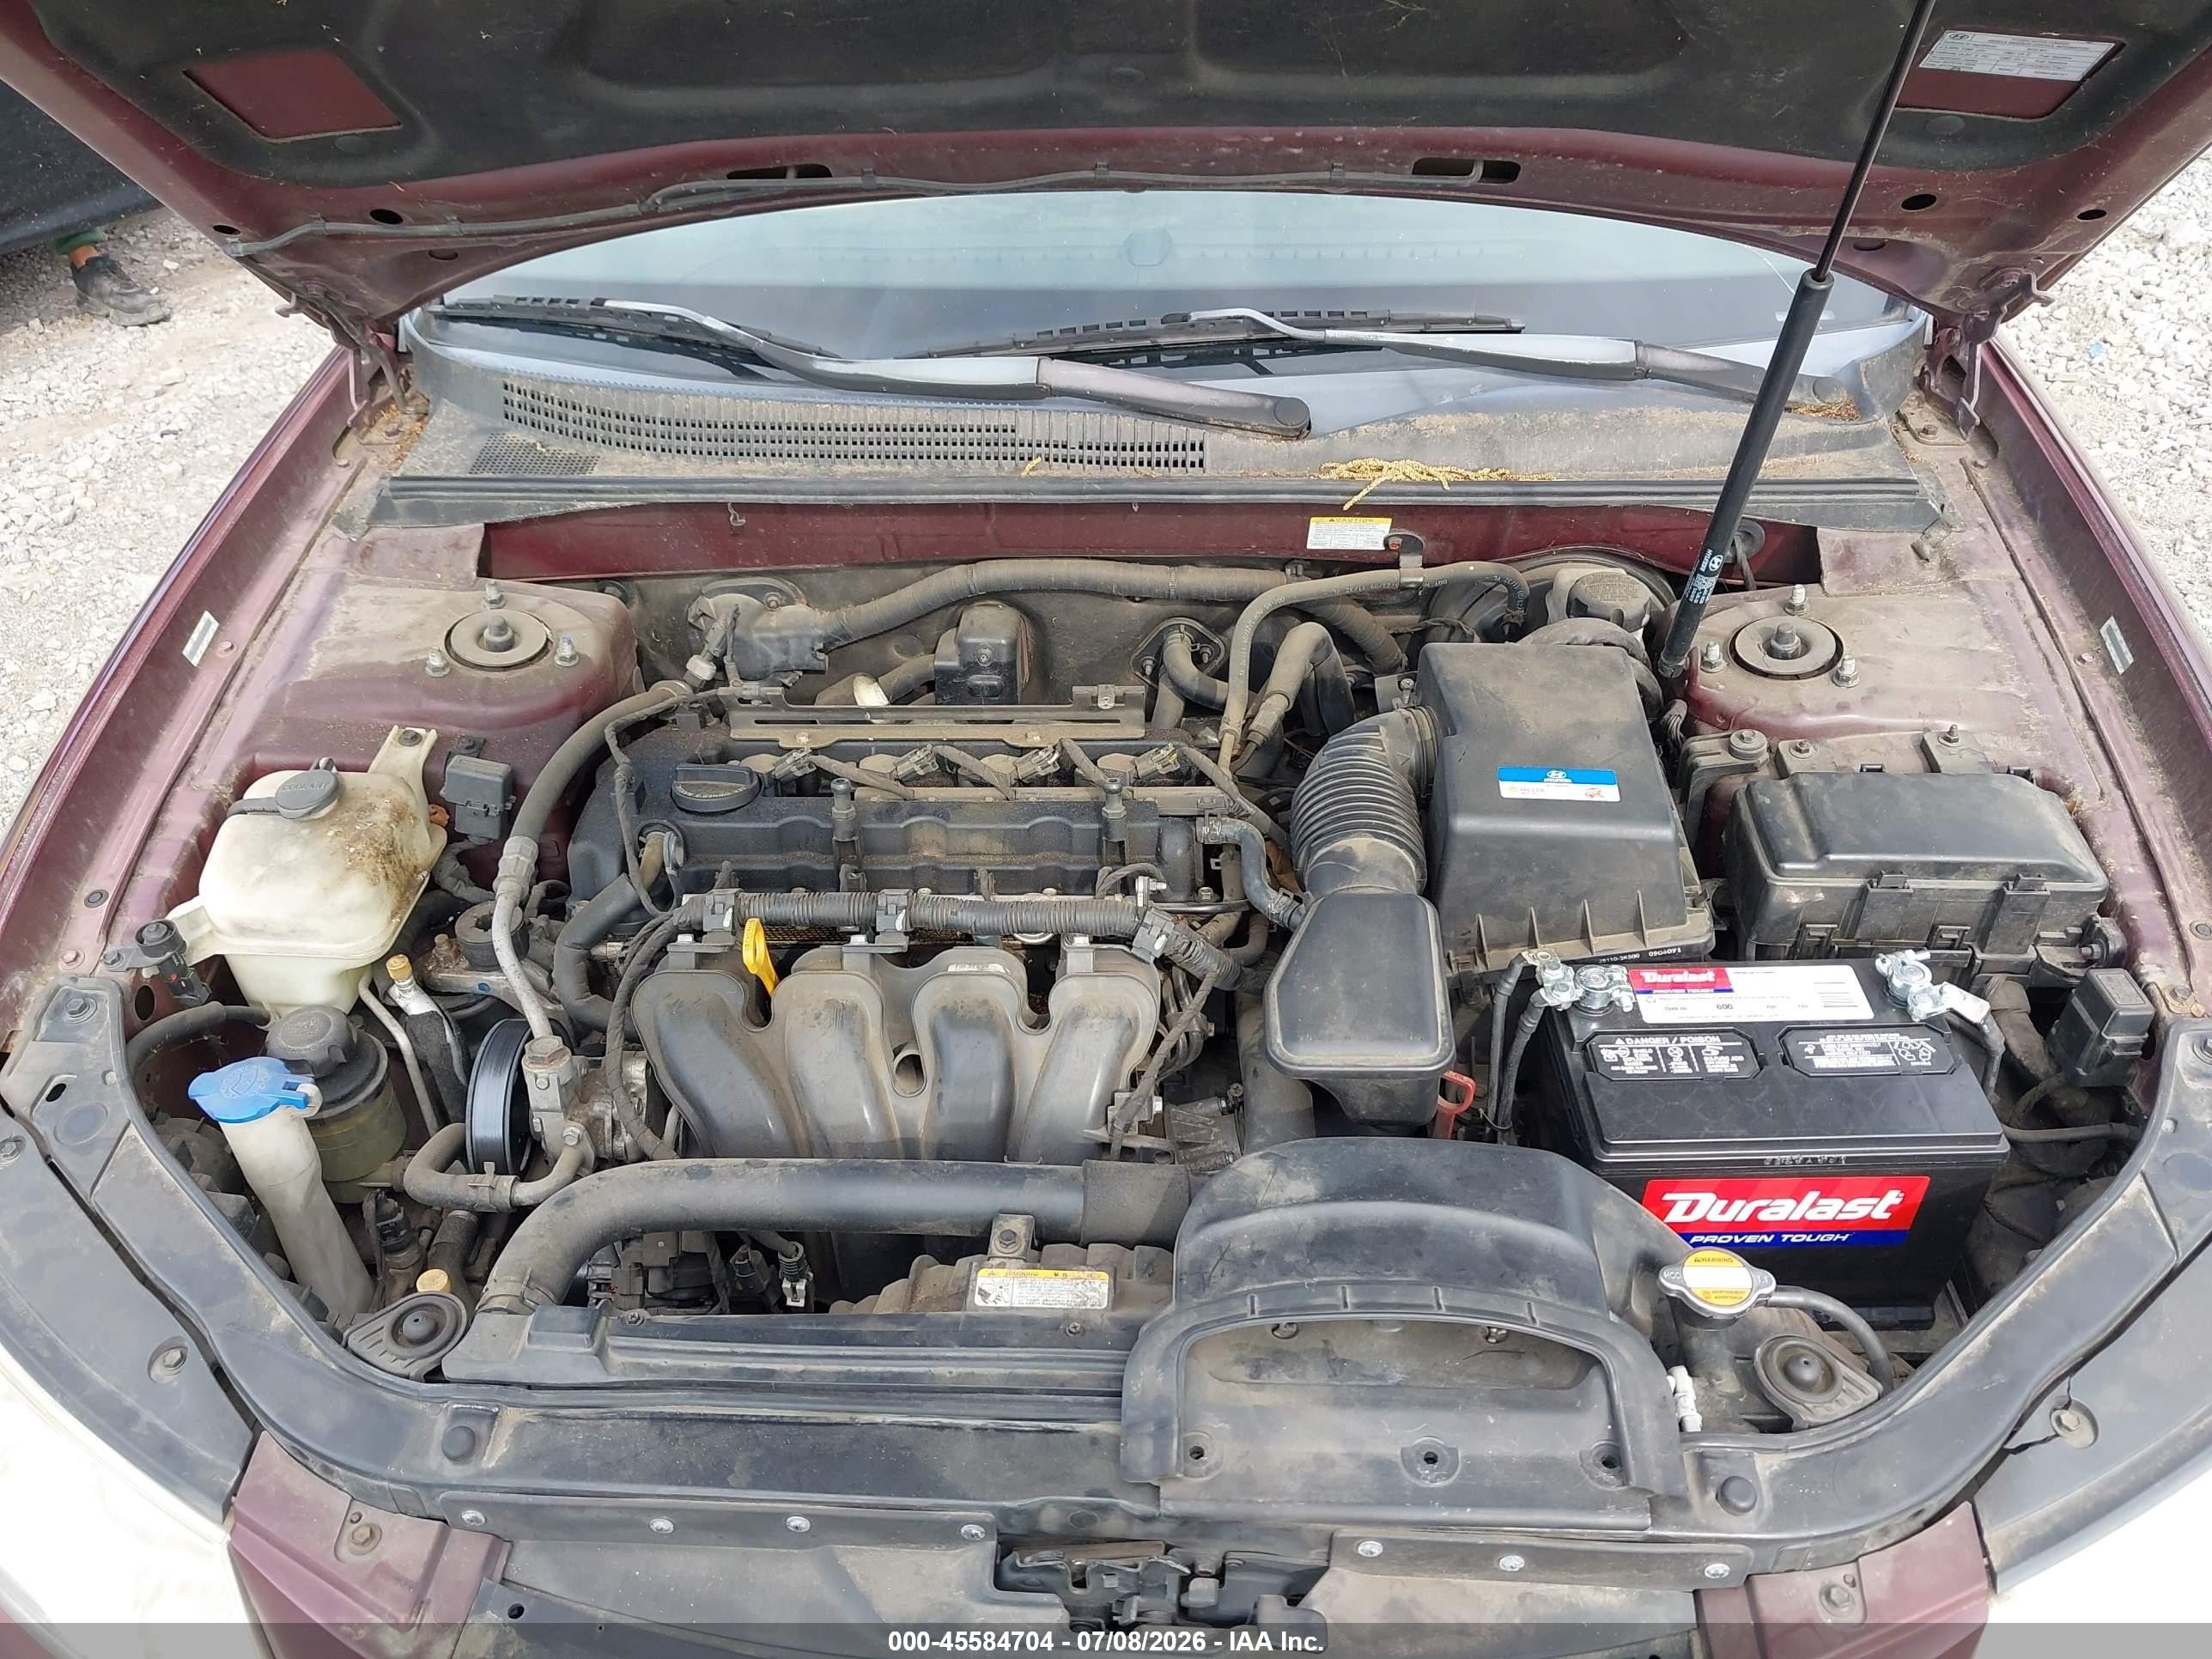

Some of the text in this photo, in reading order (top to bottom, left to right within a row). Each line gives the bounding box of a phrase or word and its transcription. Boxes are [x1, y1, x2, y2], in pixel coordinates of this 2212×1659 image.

[281, 782, 331, 791] COOLANT
[1640, 969, 1715, 983] Duralast
[1626, 1036, 1670, 1045] DANGER
[1680, 1036, 1721, 1044] POISON
[1662, 1189, 1905, 1224] Duralast
[1690, 1232, 1851, 1244] PROVEN TOUGH
